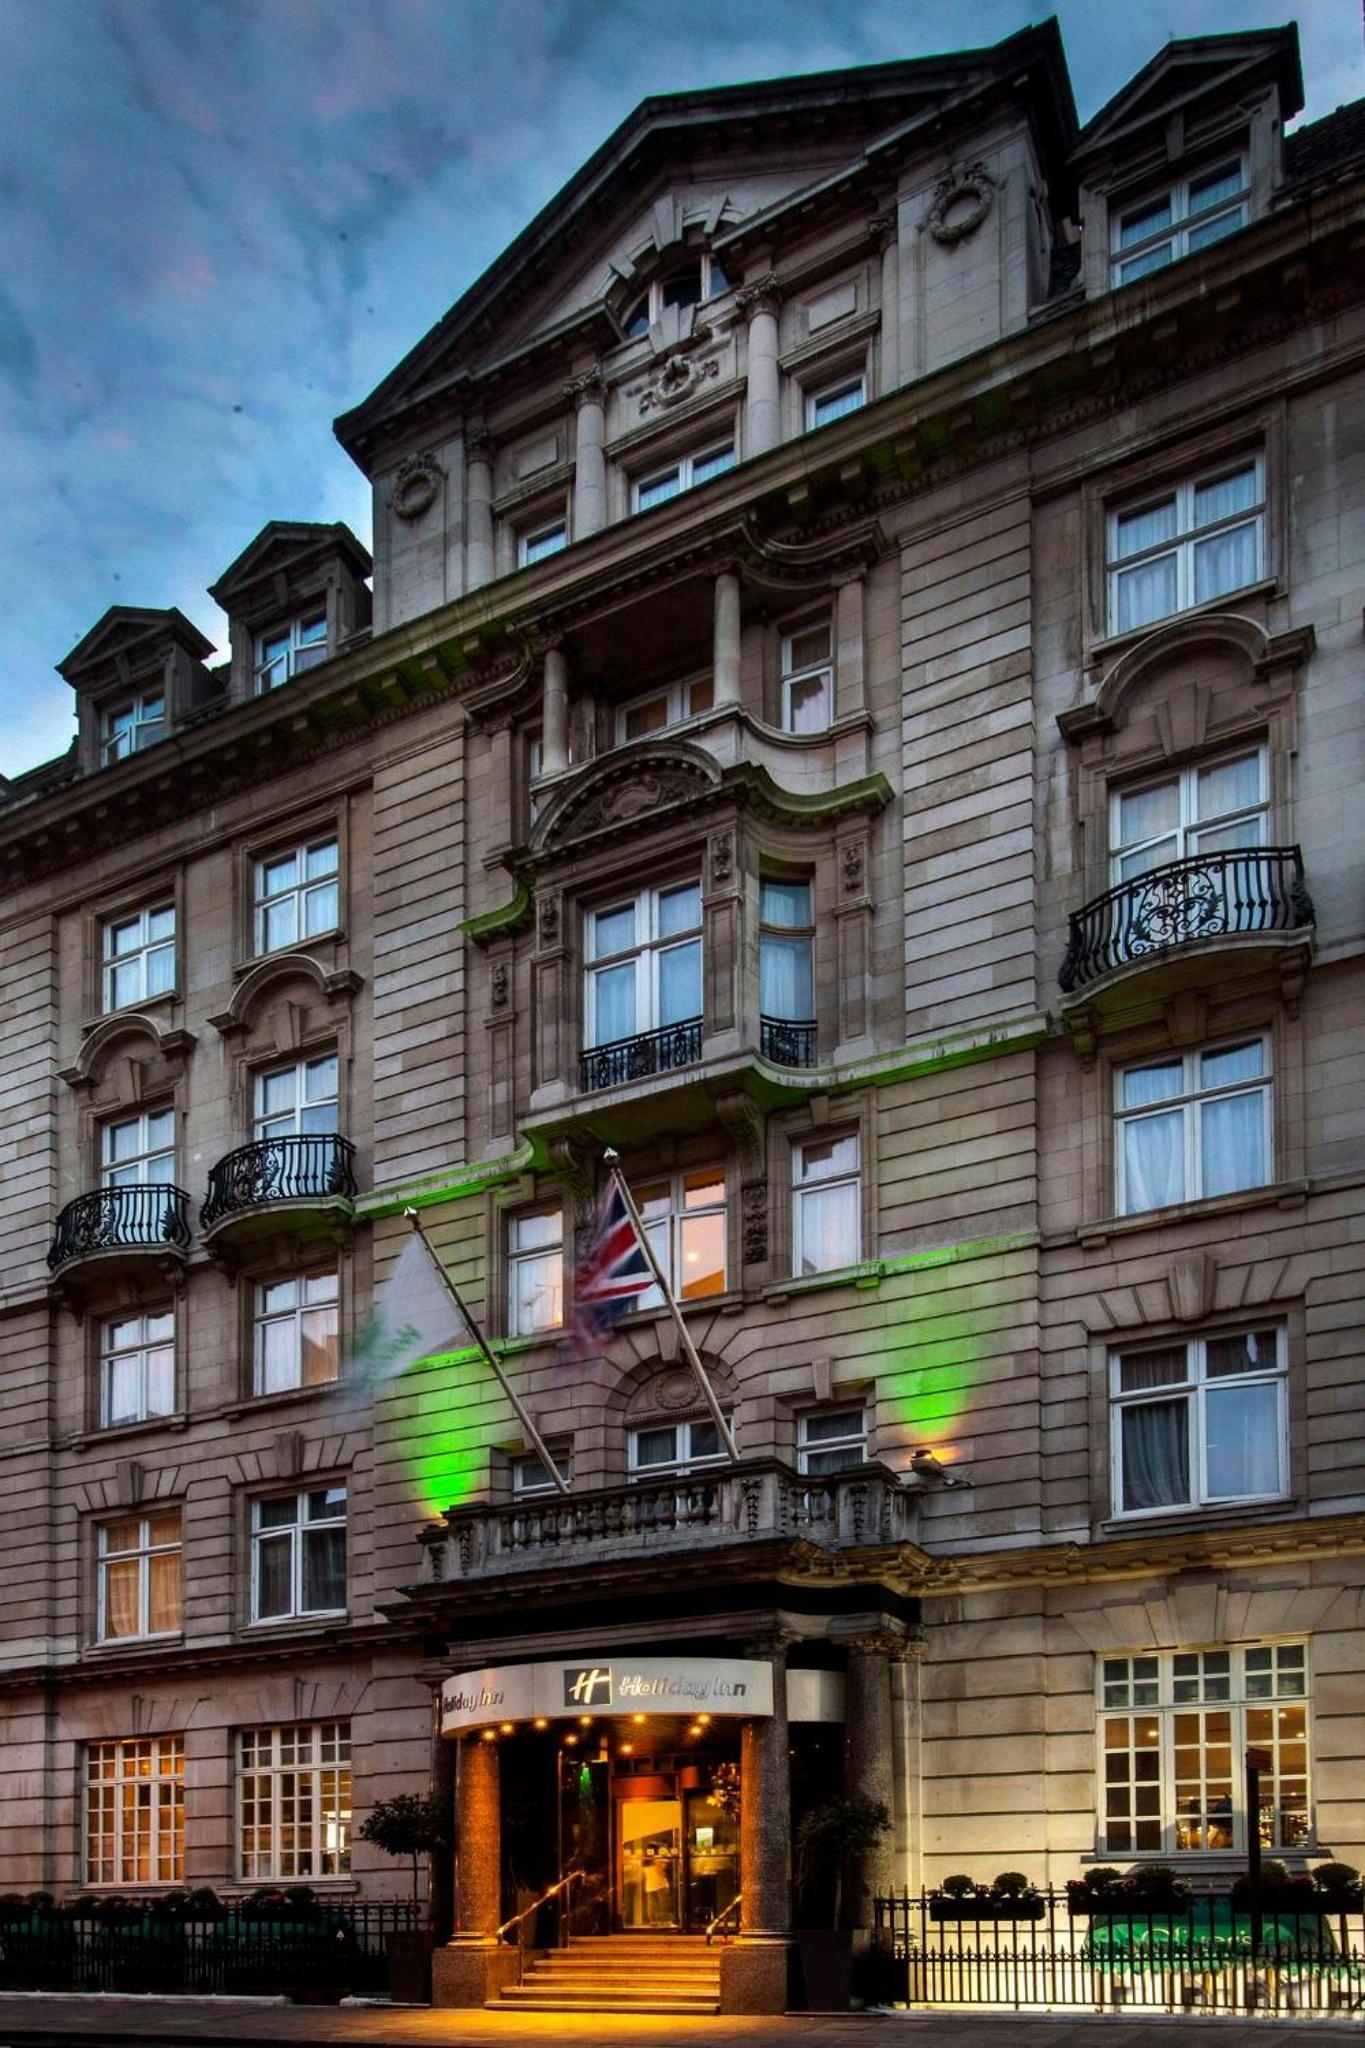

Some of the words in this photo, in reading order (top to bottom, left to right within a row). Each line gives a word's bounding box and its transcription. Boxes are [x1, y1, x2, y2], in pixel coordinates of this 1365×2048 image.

[480, 1688, 505, 1705] Inn
[619, 1676, 710, 1701] Holiday
[713, 1675, 747, 1698] Inn
